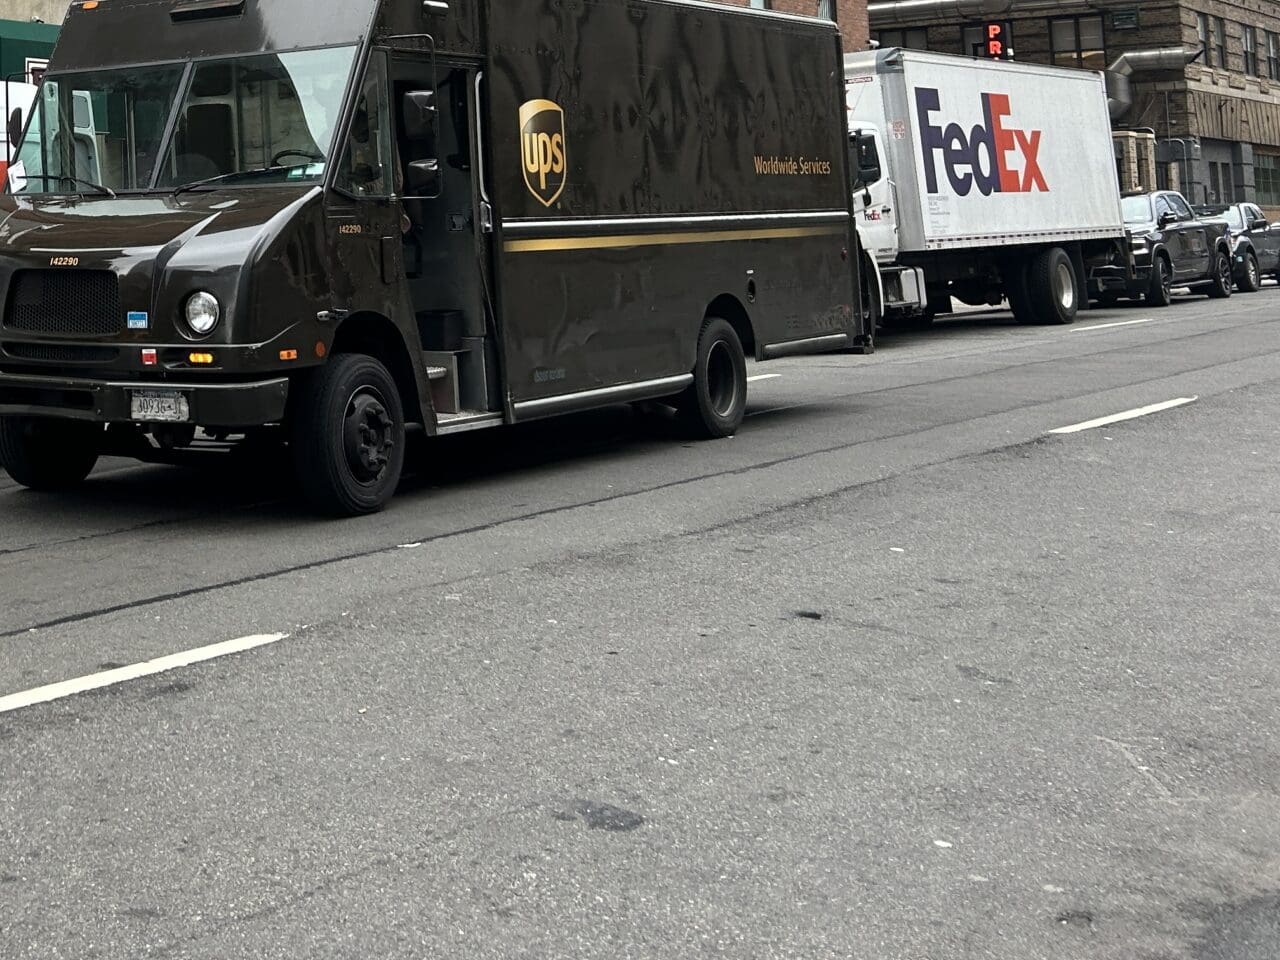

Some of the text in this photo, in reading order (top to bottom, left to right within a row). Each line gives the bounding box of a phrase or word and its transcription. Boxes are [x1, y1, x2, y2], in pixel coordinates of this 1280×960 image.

[914, 86, 1050, 196] FedEx
[524, 132, 564, 190] ups
[753, 156, 831, 175] Worldwide Services
[863, 209, 881, 221] FedEx
[339, 224, 362, 234] 142290
[49, 256, 79, 266] 142290
